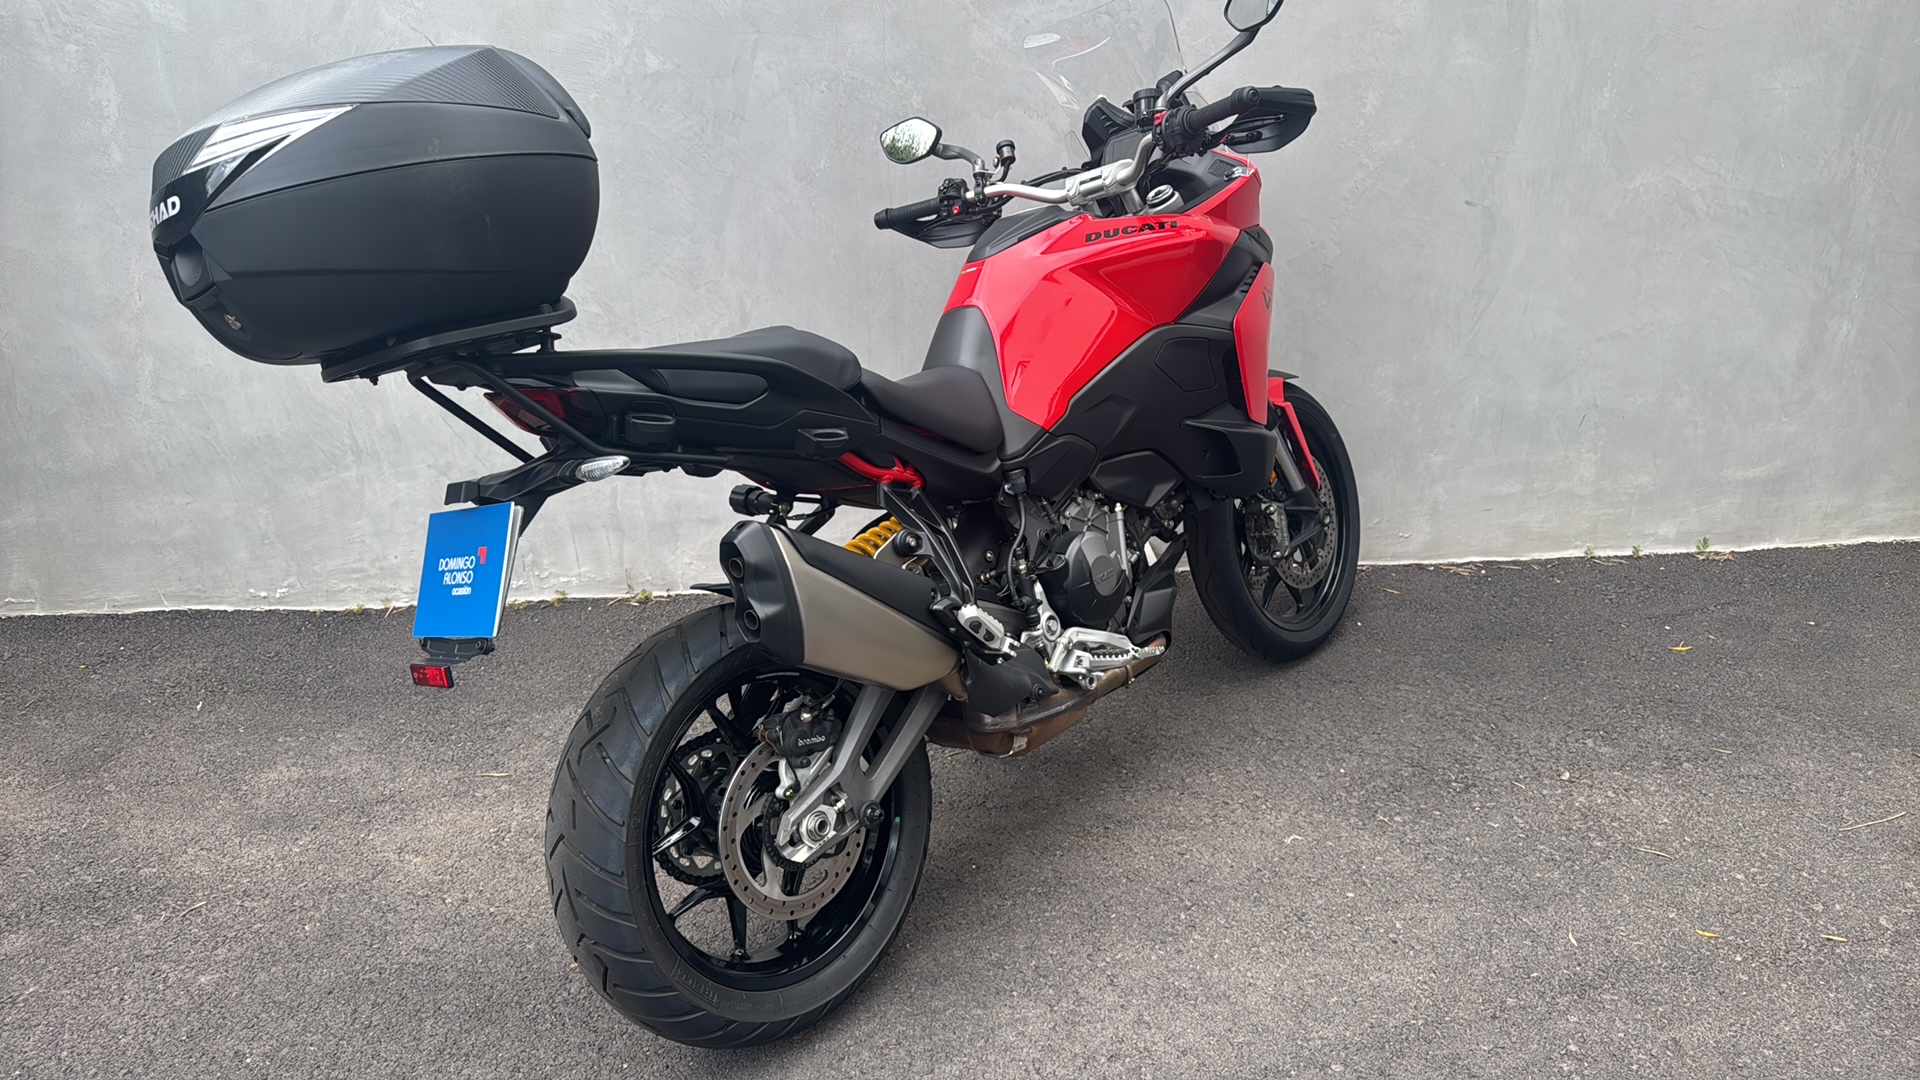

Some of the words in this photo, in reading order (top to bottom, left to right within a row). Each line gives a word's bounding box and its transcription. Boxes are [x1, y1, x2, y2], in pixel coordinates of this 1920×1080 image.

[1085, 220, 1178, 243] DUCATI
[438, 555, 476, 572] DOMINGO
[442, 570, 474, 585] ALONSO
[797, 734, 826, 747] brembo
